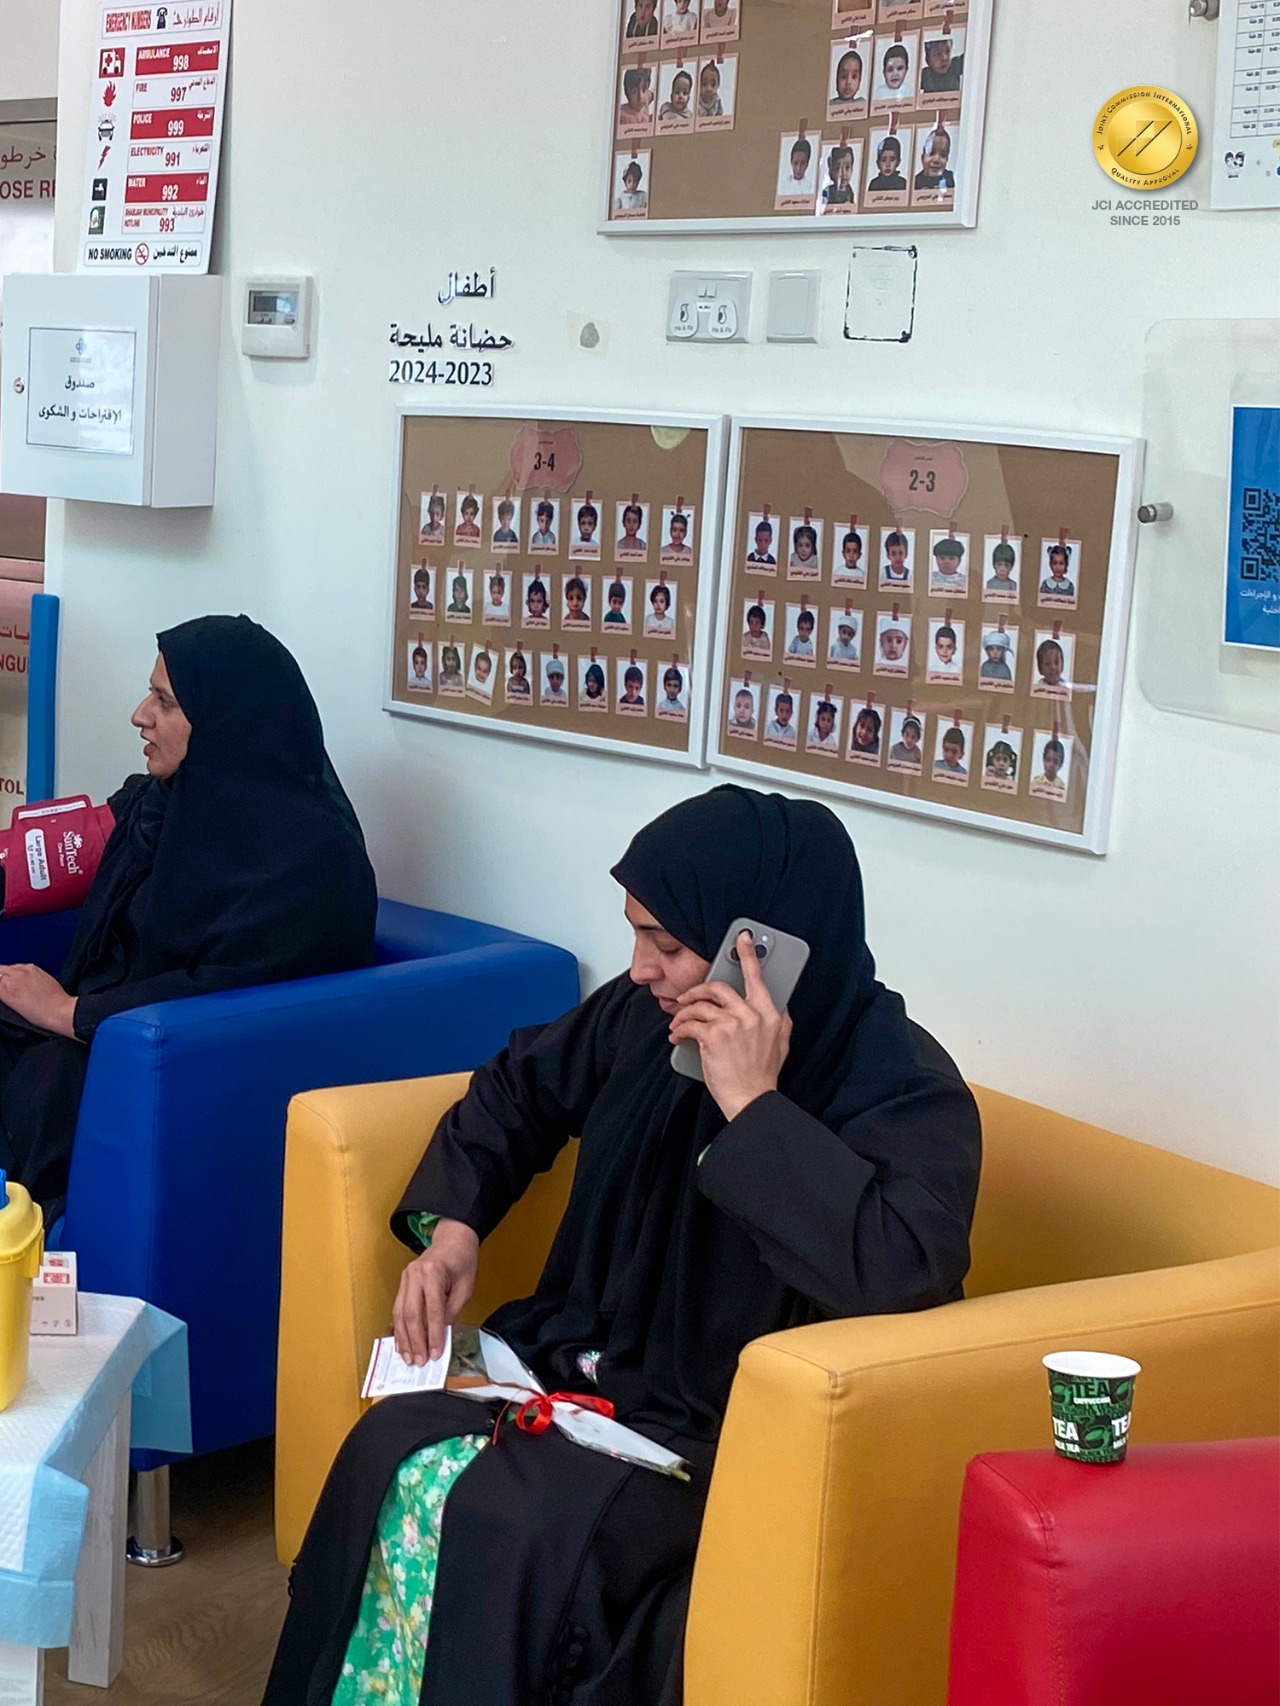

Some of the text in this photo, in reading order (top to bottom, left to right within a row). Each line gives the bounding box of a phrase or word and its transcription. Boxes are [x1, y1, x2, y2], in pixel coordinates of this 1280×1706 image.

[138, 48, 170, 60] AMBULANCE
[172, 54, 189, 71] 998
[135, 82, 148, 93] FIRE
[170, 86, 187, 102] 997
[133, 113, 153, 124] POLICE
[167, 120, 184, 136] 999
[130, 146, 164, 157] ELECTRICITY
[165, 152, 181, 167] 991
[128, 177, 146, 188] WATER
[161, 184, 178, 200] 992
[124, 207, 168, 217] SHARJAH MUNICIPALITY
[124, 219, 141, 228] HOTLINE
[159, 218, 175, 232] 993
[88, 247, 132, 261] NO SMOKING
[180, 247, 198, 263] ممنوع
[438, 266, 496, 304] أطفال
[389, 323, 513, 353] حضانة مليحة
[389, 360, 492, 386] 2024-2023
[64, 375, 95, 391] صندوق
[38, 403, 70, 420] الشكوى
[71, 411, 76, 421] و
[533, 451, 556, 472] 3-4
[908, 469, 936, 492] 2-3
[35, 835, 47, 881] Large Adult
[1071, 1380, 1111, 1398] TEA
[1052, 1415, 1079, 1441] TEA
